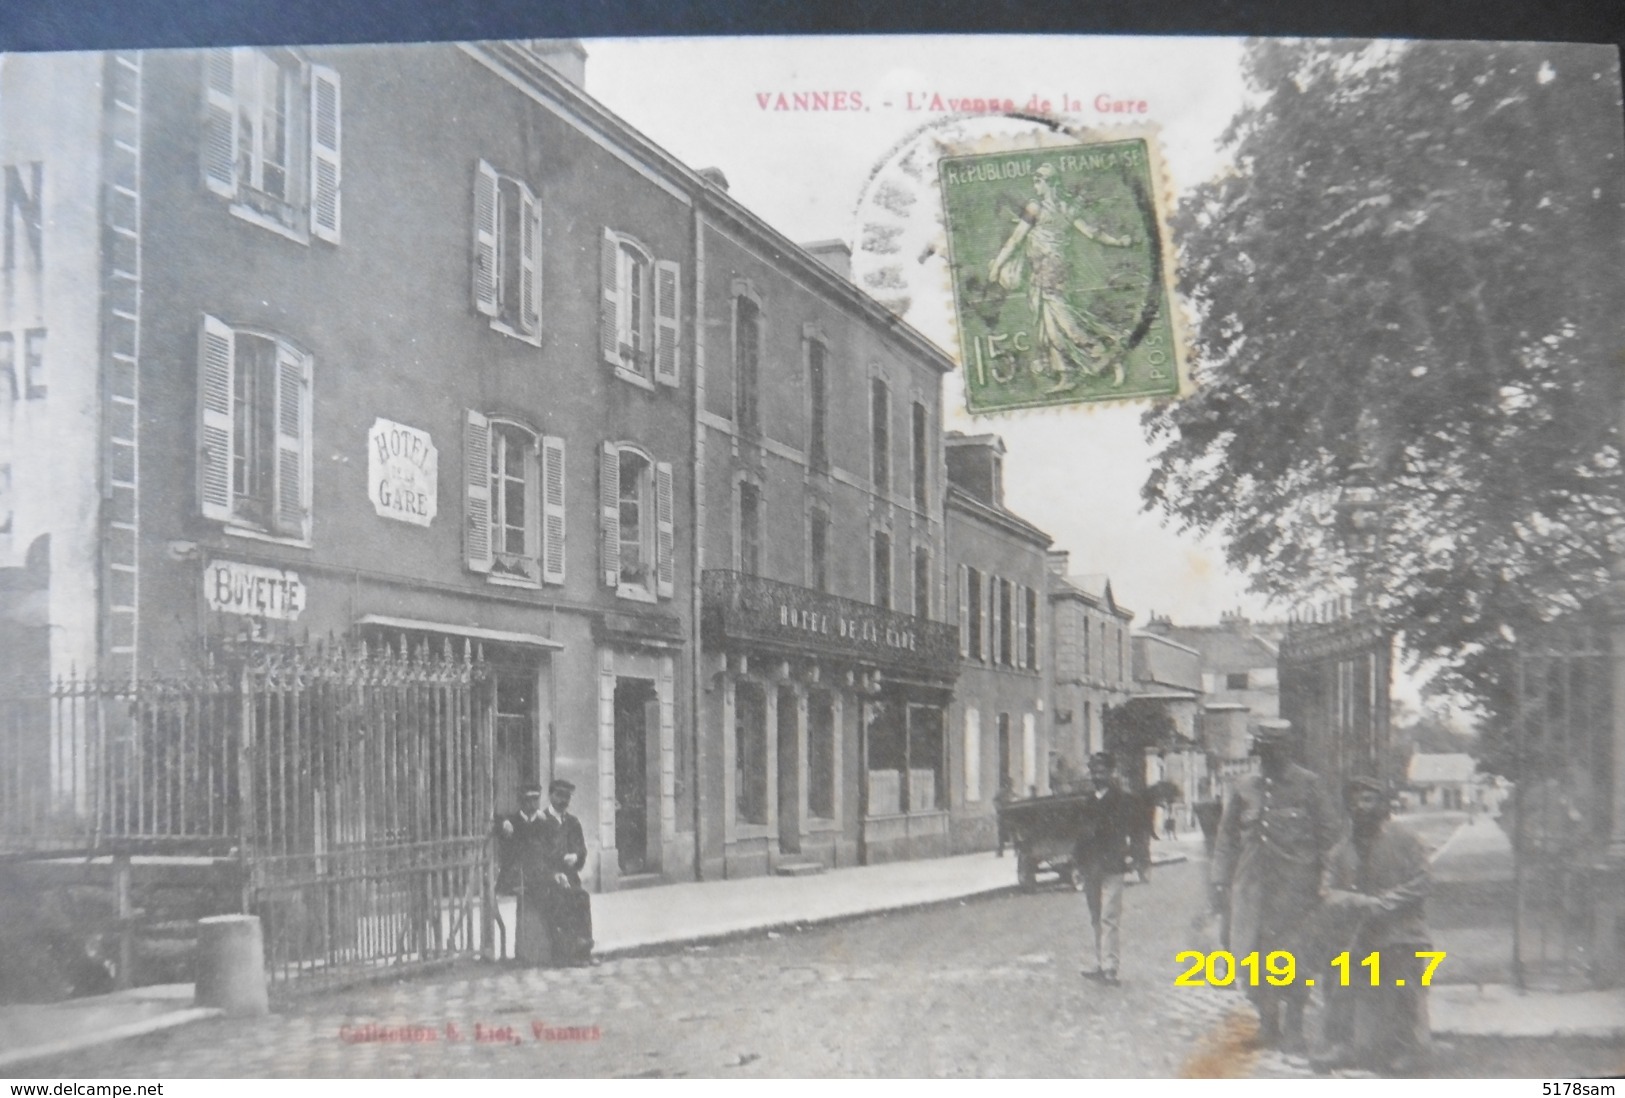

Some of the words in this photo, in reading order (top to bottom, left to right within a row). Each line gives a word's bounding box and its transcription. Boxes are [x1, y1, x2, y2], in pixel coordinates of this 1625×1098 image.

[756, 91, 870, 112] VANNES.
[1024, 94, 1051, 113] de
[1063, 93, 1081, 112] la
[1093, 94, 1149, 113] Gare
[379, 479, 428, 517] GARE
[214, 566, 300, 612] BUVETTE
